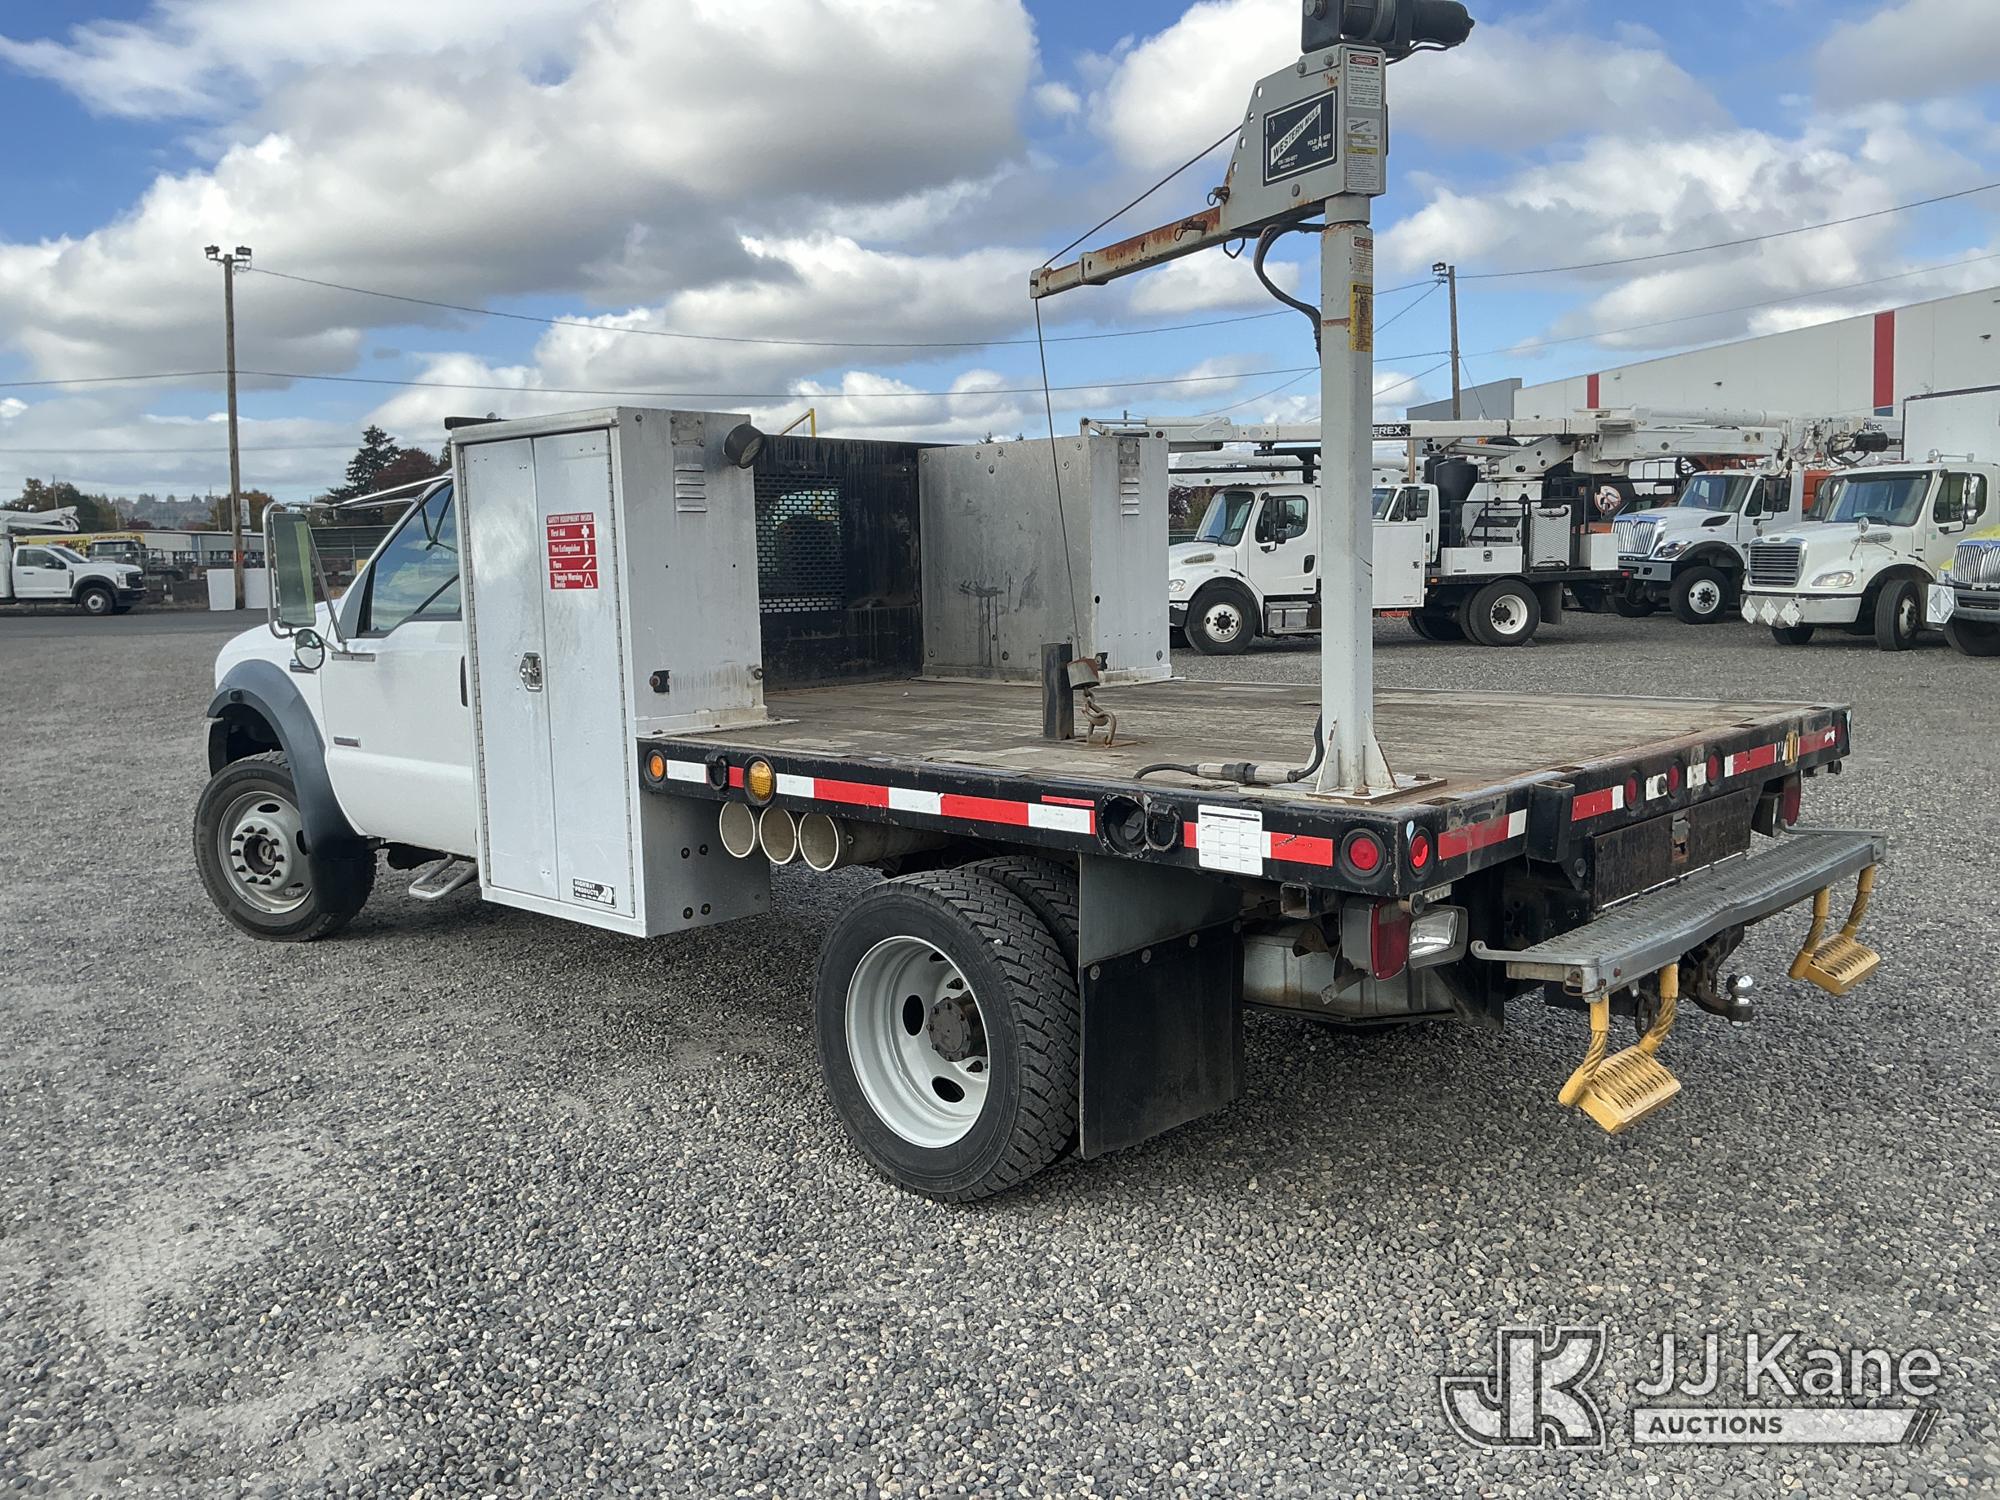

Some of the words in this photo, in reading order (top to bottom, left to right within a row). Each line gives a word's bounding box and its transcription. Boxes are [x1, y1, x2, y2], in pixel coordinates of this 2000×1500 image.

[1273, 122, 1304, 159] WESTERN
[1304, 105, 1320, 125] MULE
[1372, 426, 1402, 435] EREX
[550, 528, 559, 537] First
[575, 881, 595, 889] HIGHWAY
[575, 886, 598, 896] PRODUCTS
